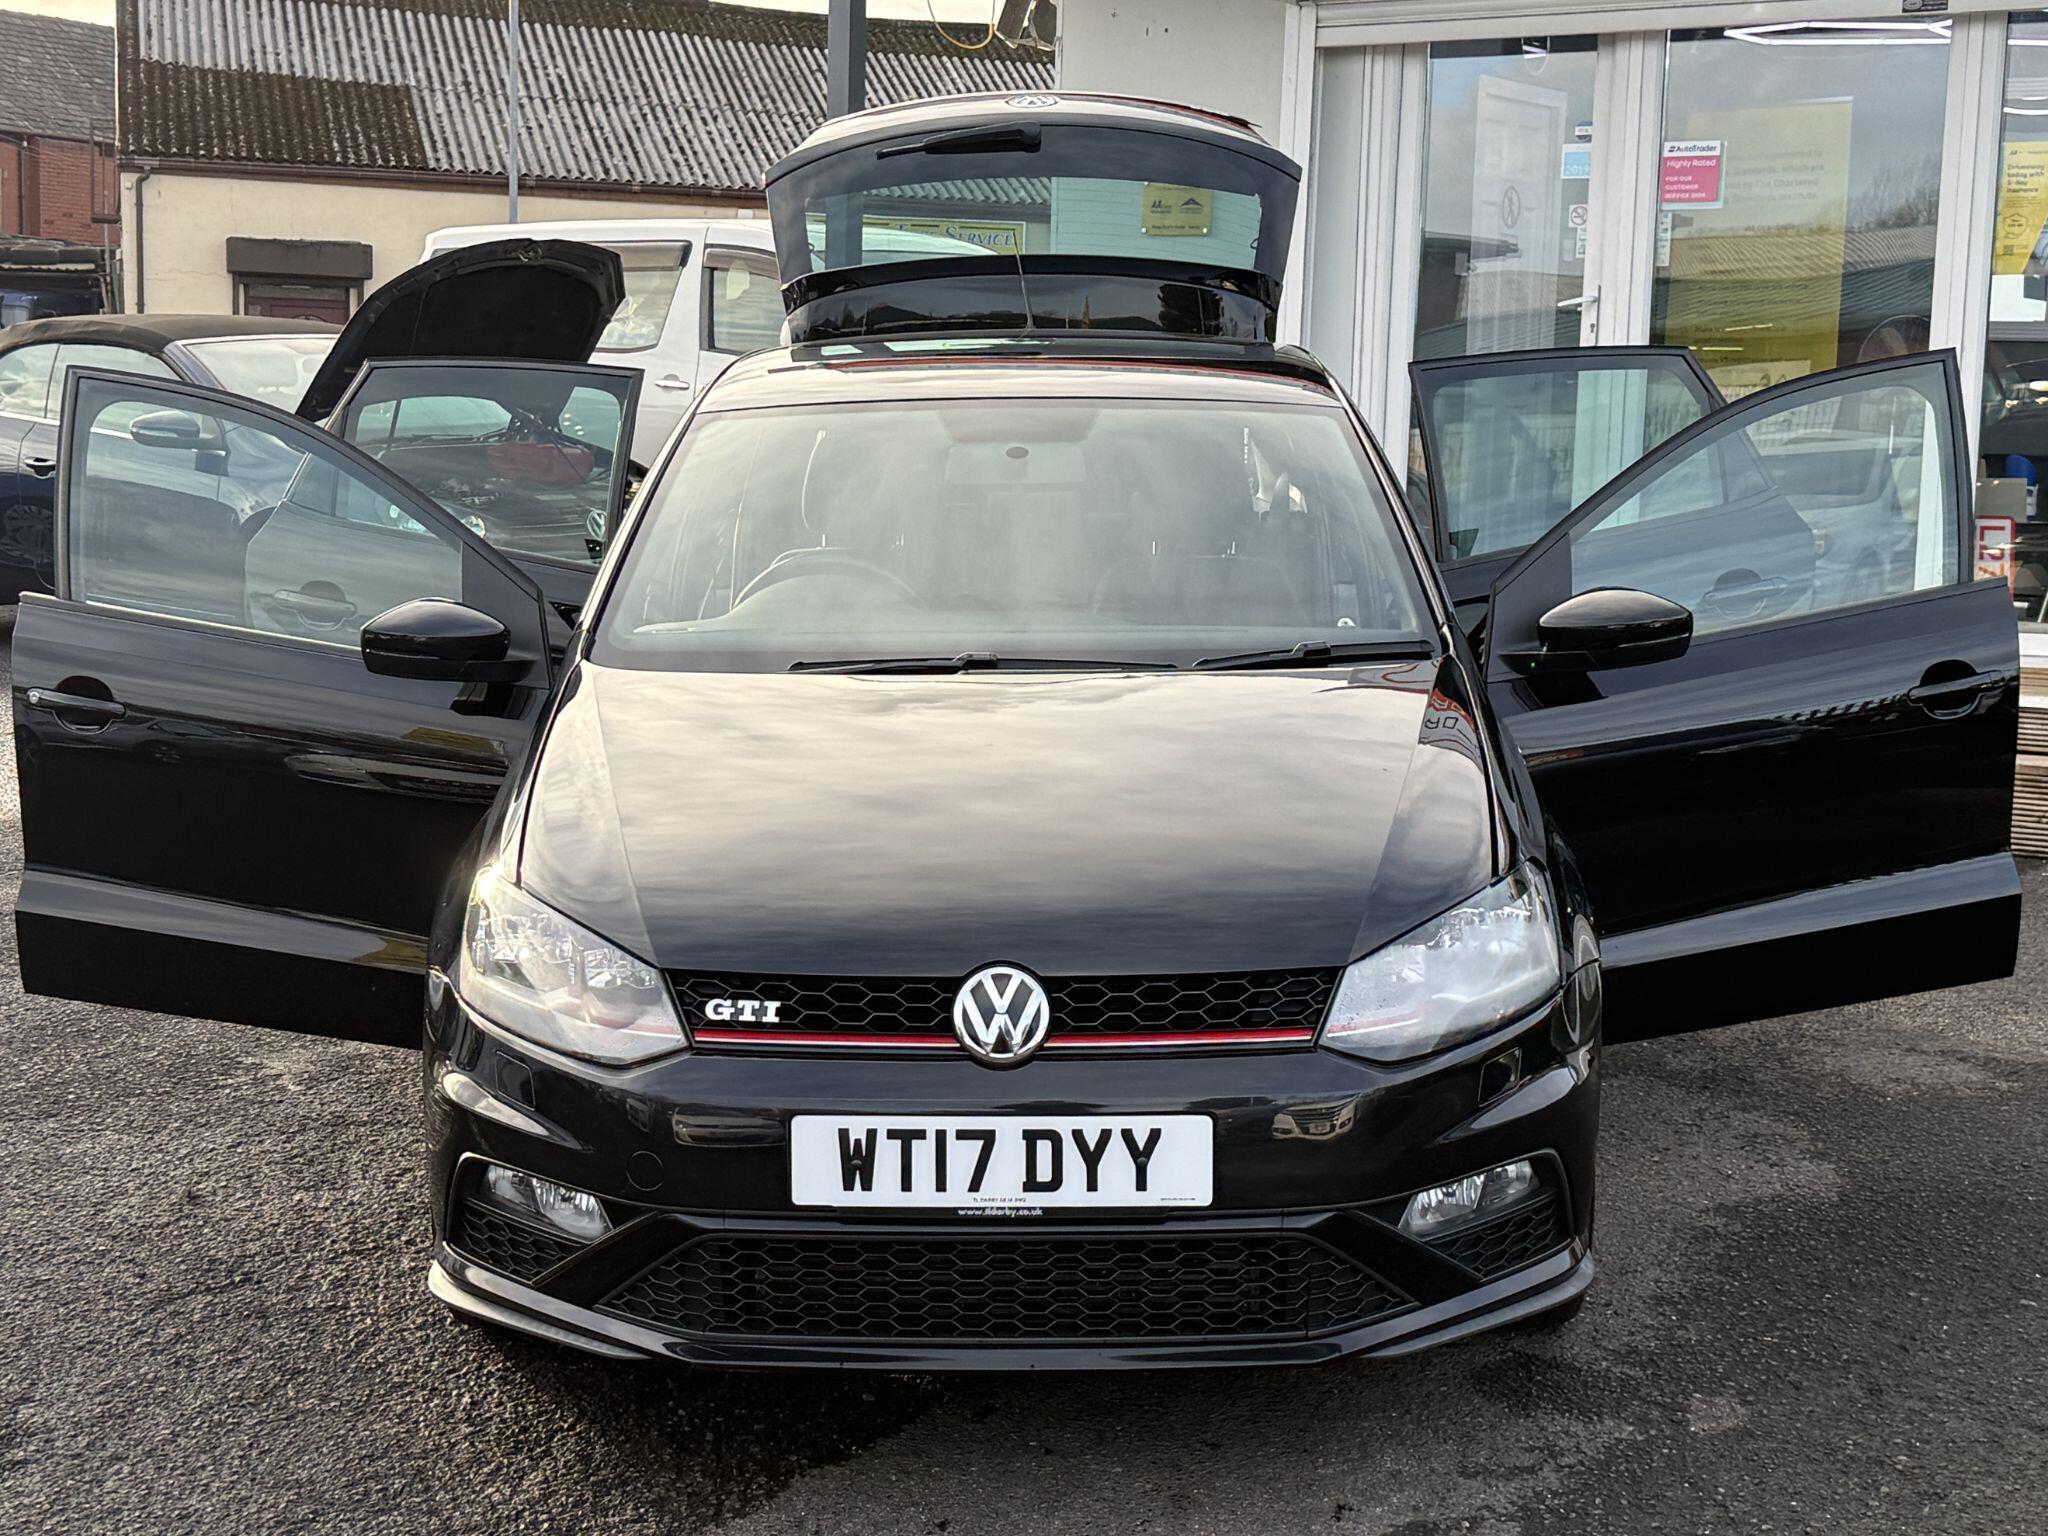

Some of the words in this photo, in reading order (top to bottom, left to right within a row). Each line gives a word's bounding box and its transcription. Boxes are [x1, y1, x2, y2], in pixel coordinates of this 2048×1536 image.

[1666, 160, 1691, 169] Highly
[1692, 159, 1716, 167] Rated
[704, 998, 782, 1023] GTI
[836, 1127, 998, 1193] WT17
[1021, 1127, 1163, 1193] DYY
